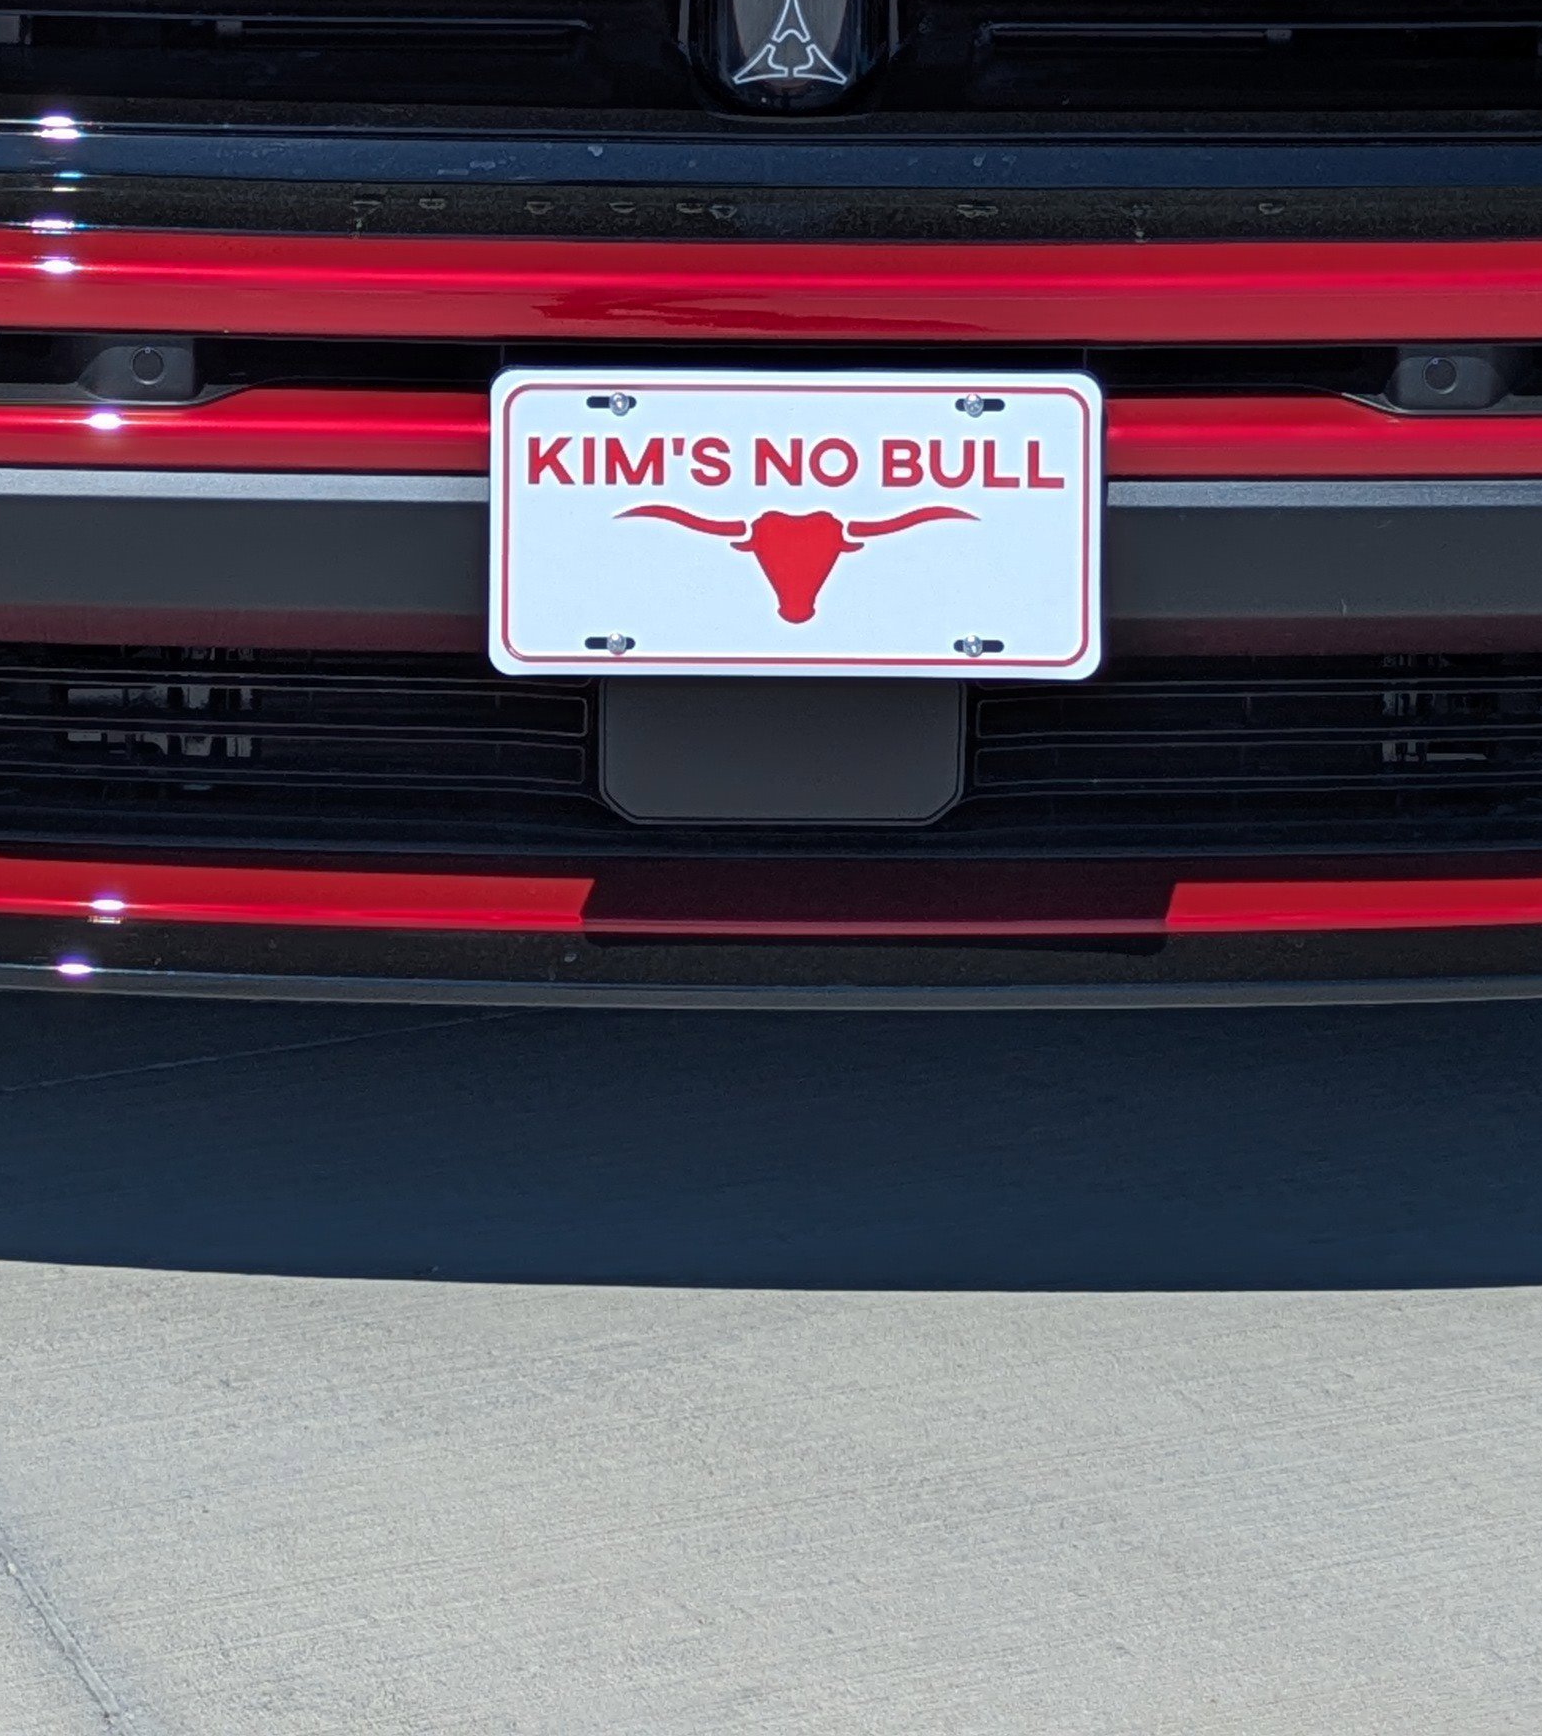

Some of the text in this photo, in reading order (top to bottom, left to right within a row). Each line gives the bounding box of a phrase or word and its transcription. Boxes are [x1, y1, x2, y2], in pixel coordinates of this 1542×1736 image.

[527, 436, 1065, 489] KIM'S NO BULL
